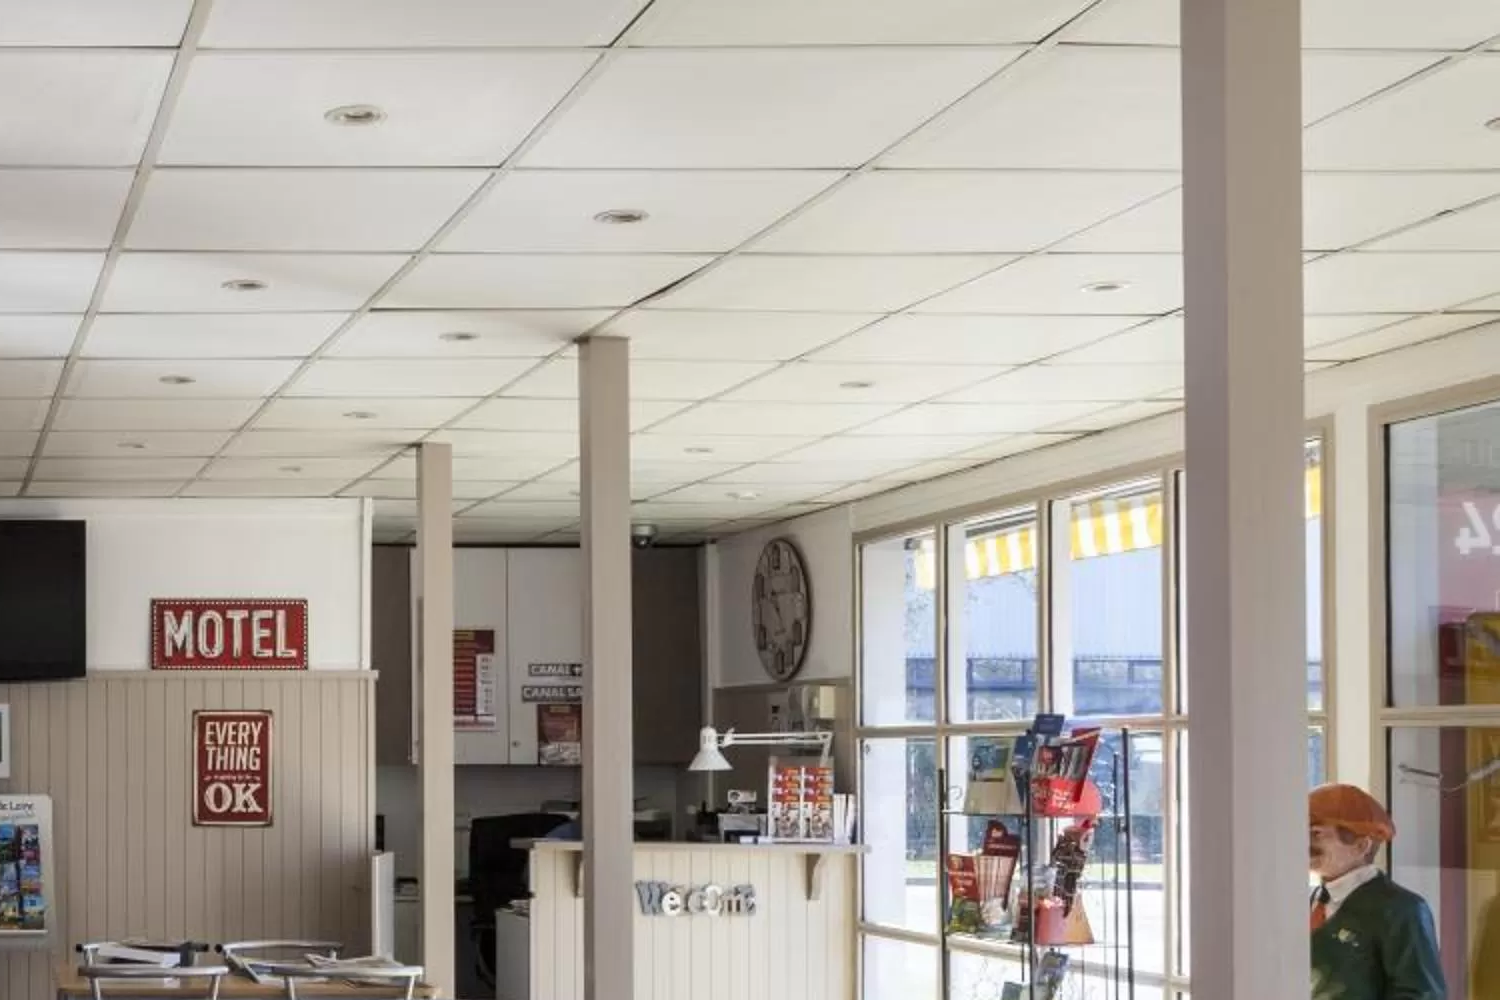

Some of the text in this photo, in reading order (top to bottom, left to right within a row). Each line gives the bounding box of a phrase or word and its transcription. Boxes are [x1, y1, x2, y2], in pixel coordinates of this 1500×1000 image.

[163, 609, 298, 659] MOTEL
[205, 721, 262, 745] EVERY
[206, 746, 260, 771] THING
[204, 782, 264, 813] OK
